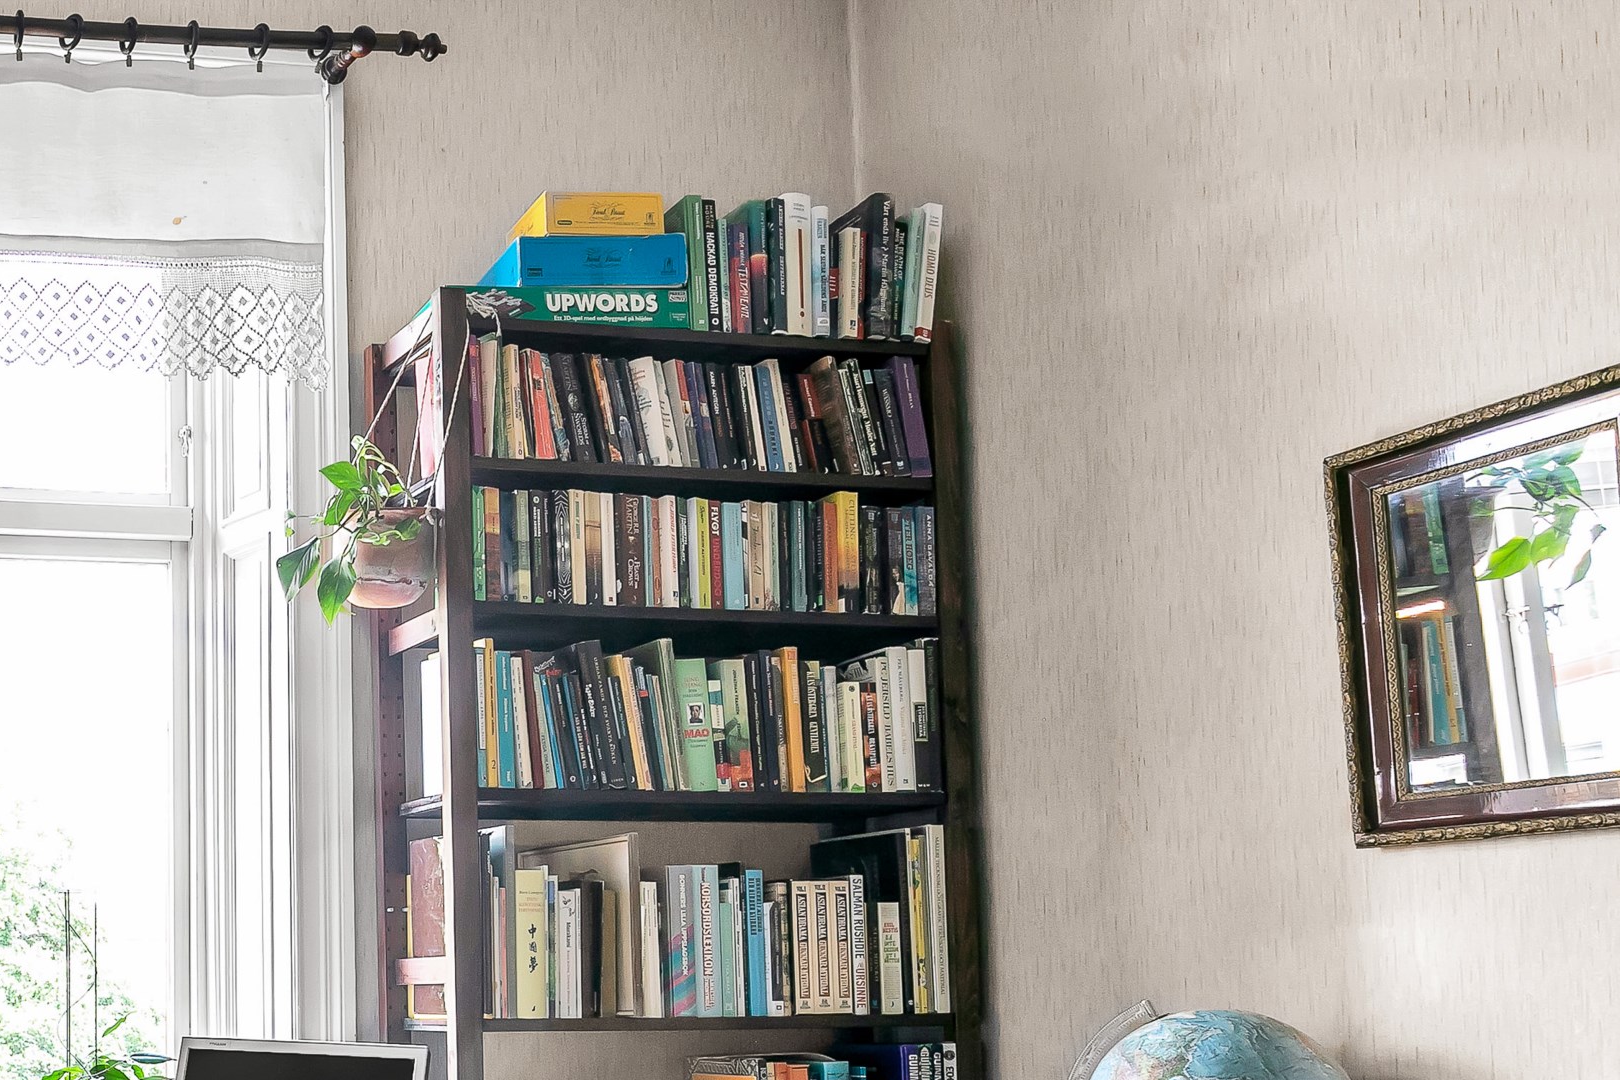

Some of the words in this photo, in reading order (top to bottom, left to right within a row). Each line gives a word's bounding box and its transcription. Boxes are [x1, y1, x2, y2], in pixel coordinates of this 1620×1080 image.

[883, 200, 891, 216] Vårt
[882, 217, 890, 235] enda
[706, 232, 717, 265] HACKAD
[882, 236, 890, 246] liv
[881, 253, 889, 278] Martin
[898, 270, 904, 281] OF
[925, 249, 936, 275] HOMO
[708, 268, 719, 314] DEMOKRATI
[738, 268, 750, 318] TESTAMENTE
[924, 277, 936, 299] DEUS
[546, 292, 658, 313] UPWORDS
[627, 315, 636, 323] på
[636, 315, 653, 323] höjden
[711, 389, 720, 415] ALVTEGEN
[574, 413, 584, 446] SWORDS
[855, 388, 868, 419] Vonnegut
[864, 420, 875, 442] Moder
[870, 442, 878, 456] Natt
[626, 497, 635, 534] MARTIN
[627, 559, 635, 587] CROWS
[713, 538, 722, 596] UNDERDOG
[806, 671, 815, 686] KLAS
[880, 661, 887, 675] PC
[807, 686, 818, 718] ÖSTERGREN
[881, 677, 891, 720] JERSILD
[605, 719, 614, 743] SVARTA
[684, 728, 711, 739] MAO
[809, 722, 820, 754] GENTLEMEN
[884, 724, 893, 763] BABELS
[886, 765, 894, 786] HUS
[679, 875, 687, 908] BONNIERS
[816, 893, 826, 914] ASIAN
[853, 879, 862, 916] SALMAN
[797, 895, 806, 916] ASIAN
[836, 895, 846, 916] ASIAN
[700, 882, 713, 977] KORSORDSLEXIKON
[797, 916, 807, 941] DRAMA
[817, 914, 827, 939] DRAMA
[837, 916, 847, 941] DRAMA
[854, 920, 865, 959] RUSHDIE
[681, 927, 689, 976] UPPSLAGSBOK
[798, 941, 808, 969] GUNNAR
[818, 940, 829, 967] GUNNAR
[839, 941, 849, 968] GUNNAR
[800, 969, 810, 998] MYRDAL
[820, 967, 830, 996] MYRDAL
[840, 968, 850, 997] MYRDAL
[856, 968, 866, 1009] URSINNE
